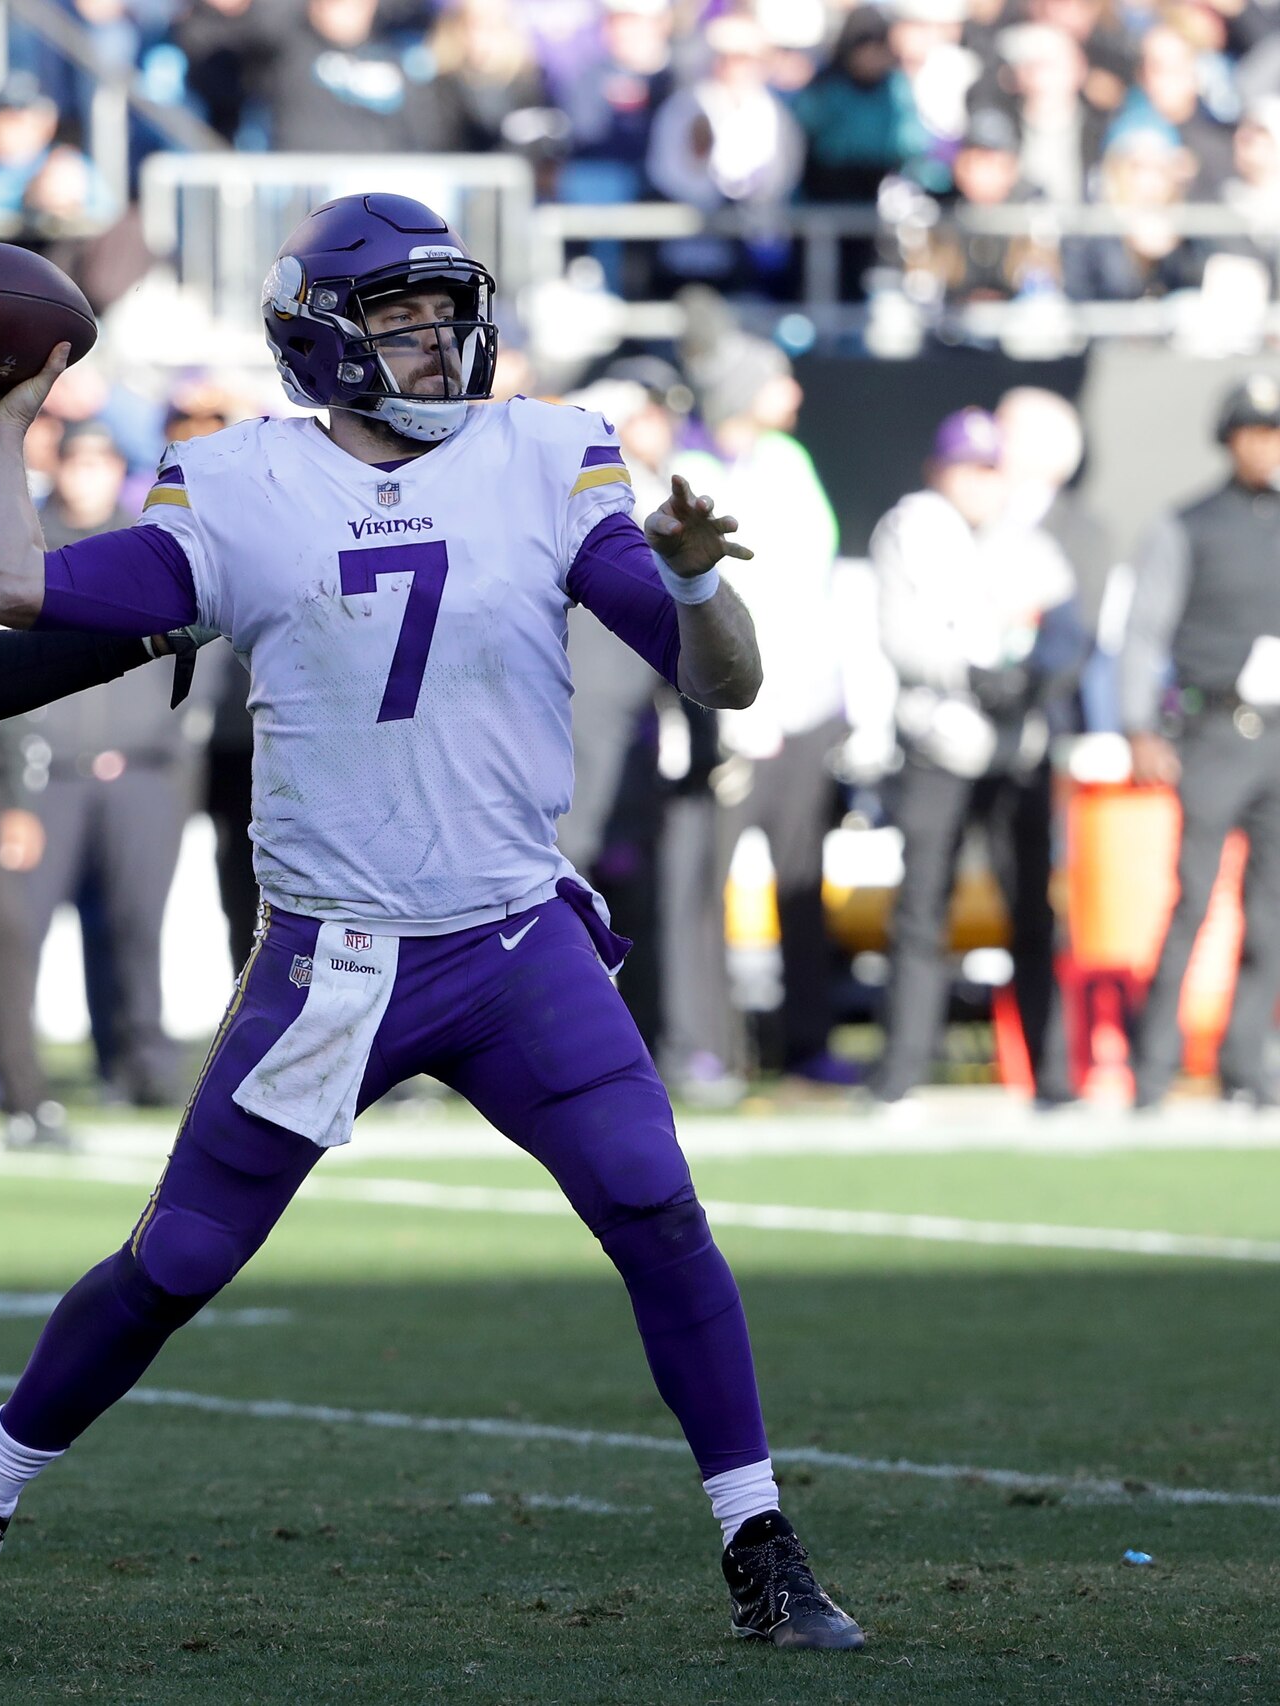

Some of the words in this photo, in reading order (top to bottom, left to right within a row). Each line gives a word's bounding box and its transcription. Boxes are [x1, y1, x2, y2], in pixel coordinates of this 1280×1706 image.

[379, 492, 397, 504] NFL
[338, 540, 449, 724] 7
[346, 935, 370, 950] NFL
[330, 958, 376, 975] Wilson
